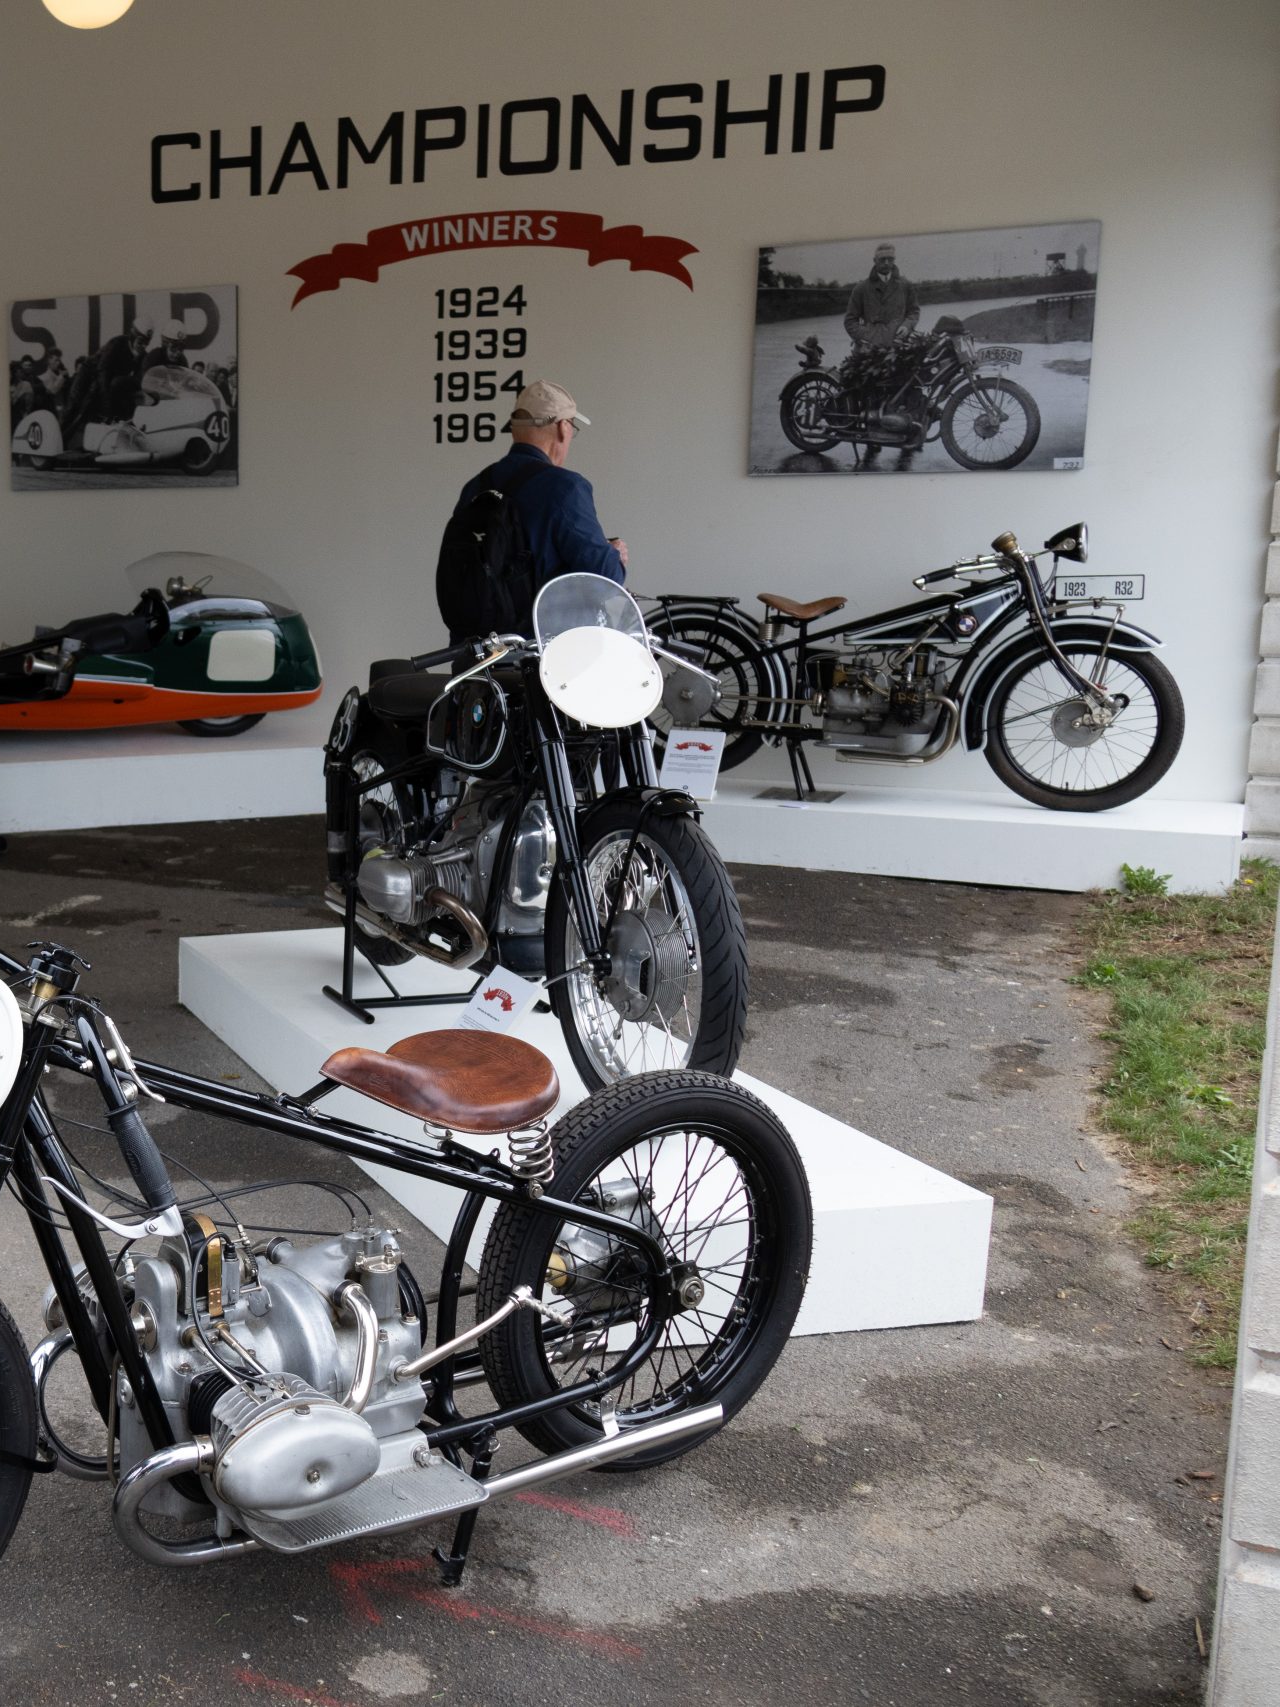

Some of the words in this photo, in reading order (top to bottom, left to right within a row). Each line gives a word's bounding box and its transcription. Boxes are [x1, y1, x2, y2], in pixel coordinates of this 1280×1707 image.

[150, 64, 887, 204] CHAMPIONSHIP
[401, 215, 558, 252] WINNERS
[435, 284, 527, 319] 1924
[434, 327, 527, 361] 1939
[433, 370, 526, 403] 1954
[207, 416, 229, 439] 40
[1063, 582, 1086, 597] 1923
[1115, 581, 1134, 596] R32
